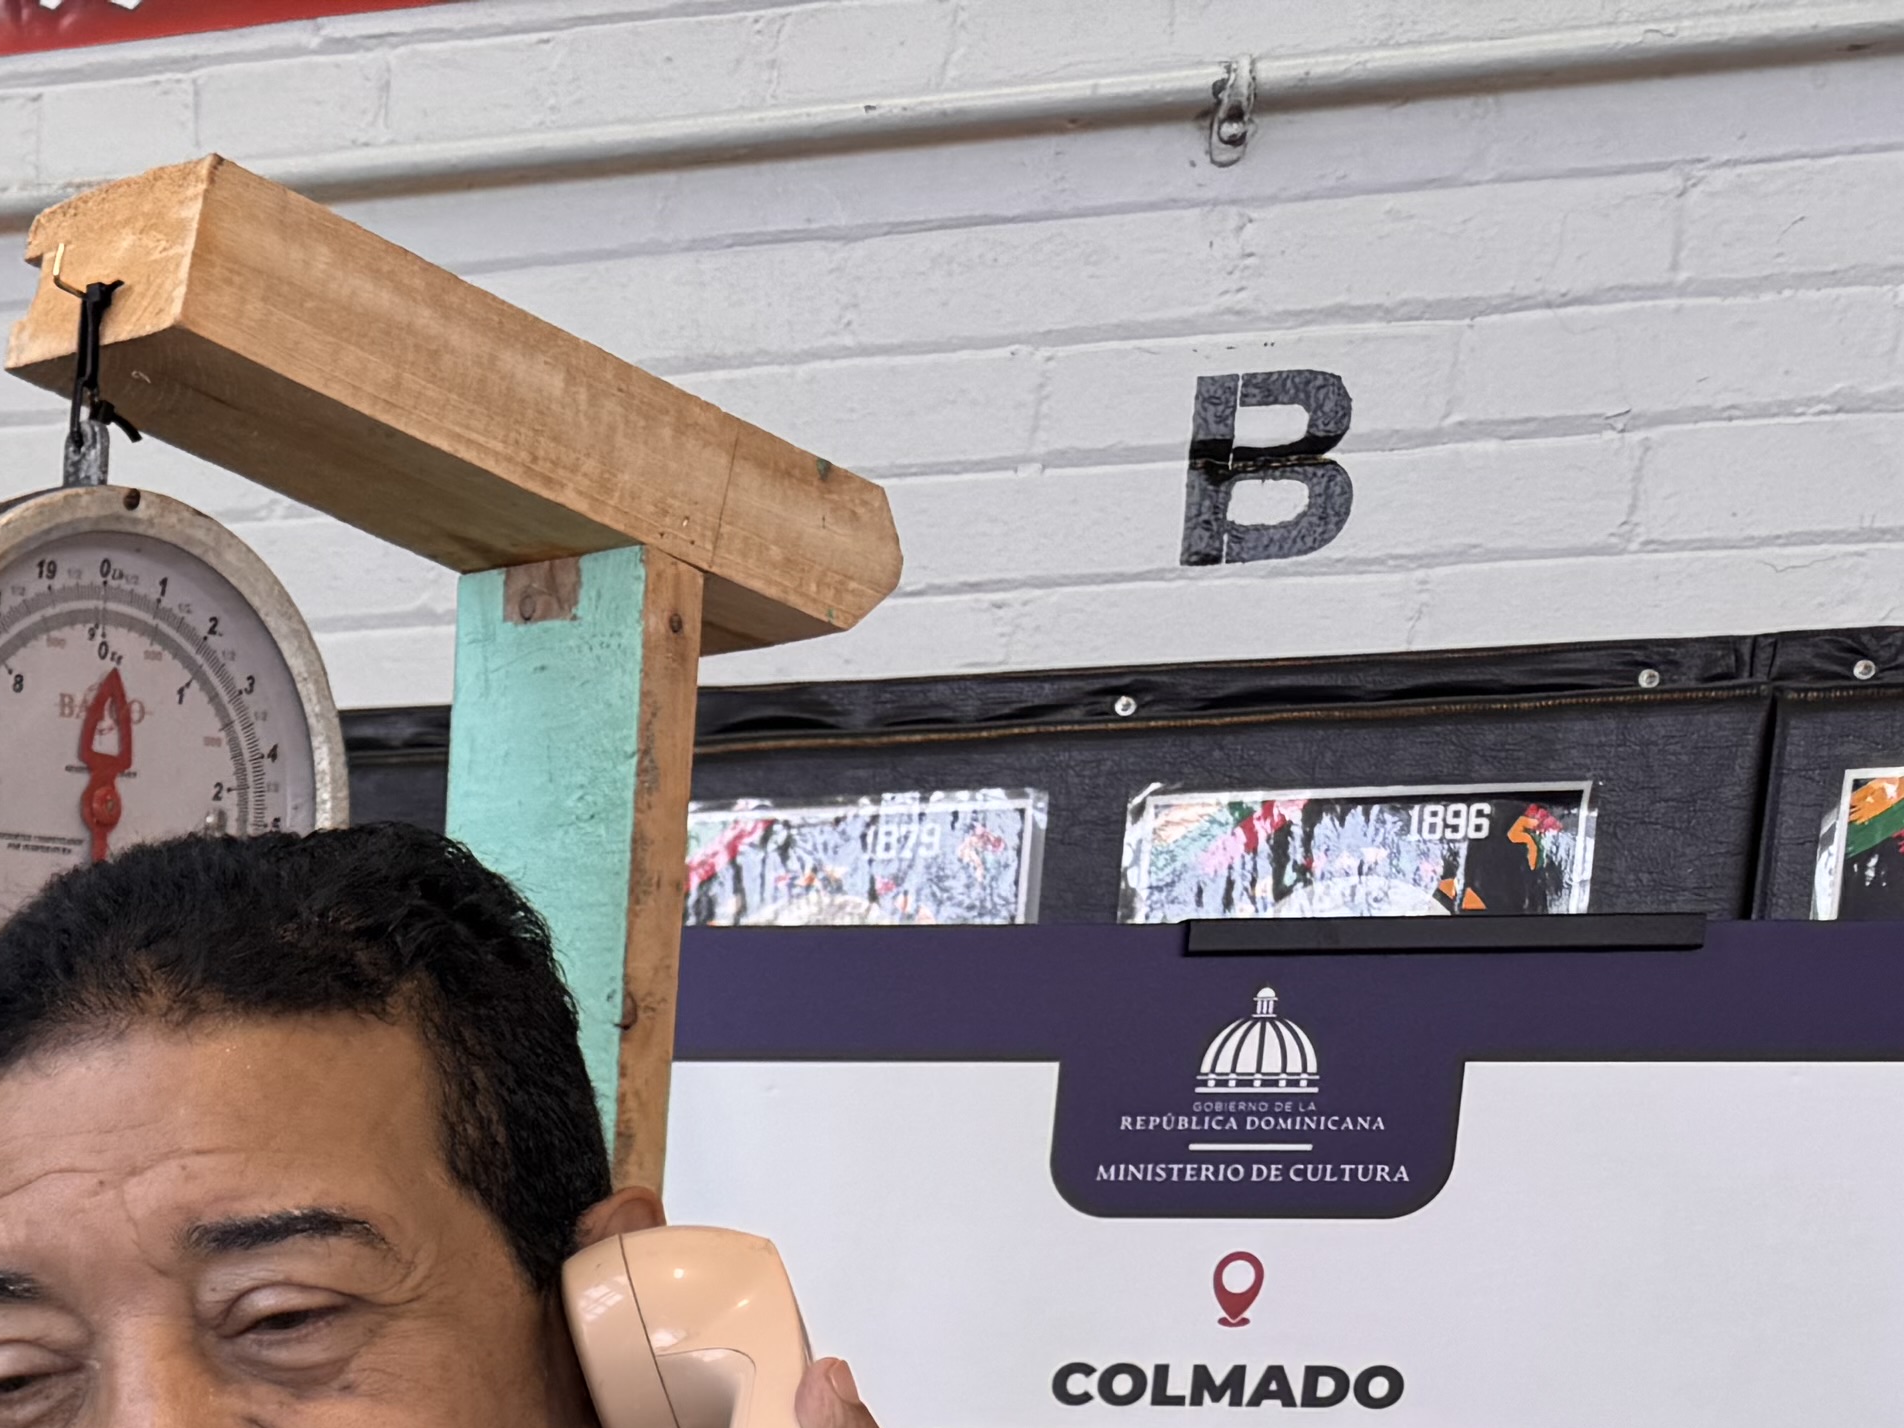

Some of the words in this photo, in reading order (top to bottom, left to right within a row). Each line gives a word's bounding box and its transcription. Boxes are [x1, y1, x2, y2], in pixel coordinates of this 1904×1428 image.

[1180, 368, 1352, 566] B
[37, 559, 58, 580] 19
[99, 558, 111, 578] 0
[158, 577, 168, 598] 1
[207, 616, 219, 636] 2
[98, 640, 109, 660] 0
[12, 673, 24, 693] 8
[244, 675, 256, 694] 3
[267, 743, 279, 763] 4
[212, 782, 224, 801] 2
[1407, 803, 1492, 840] 1896
[1193, 1101, 1269, 1113] GOBIERNO
[1274, 1101, 1292, 1112] DE
[1298, 1101, 1317, 1112] LA
[1120, 1112, 1239, 1131] REPÚBLICA
[1246, 1116, 1386, 1131] DOMINICANA
[1096, 1163, 1244, 1182] MINISTERIO
[1251, 1163, 1284, 1182] DE
[1289, 1163, 1410, 1182] CULTURA
[1051, 1361, 1406, 1410] COLMADO
